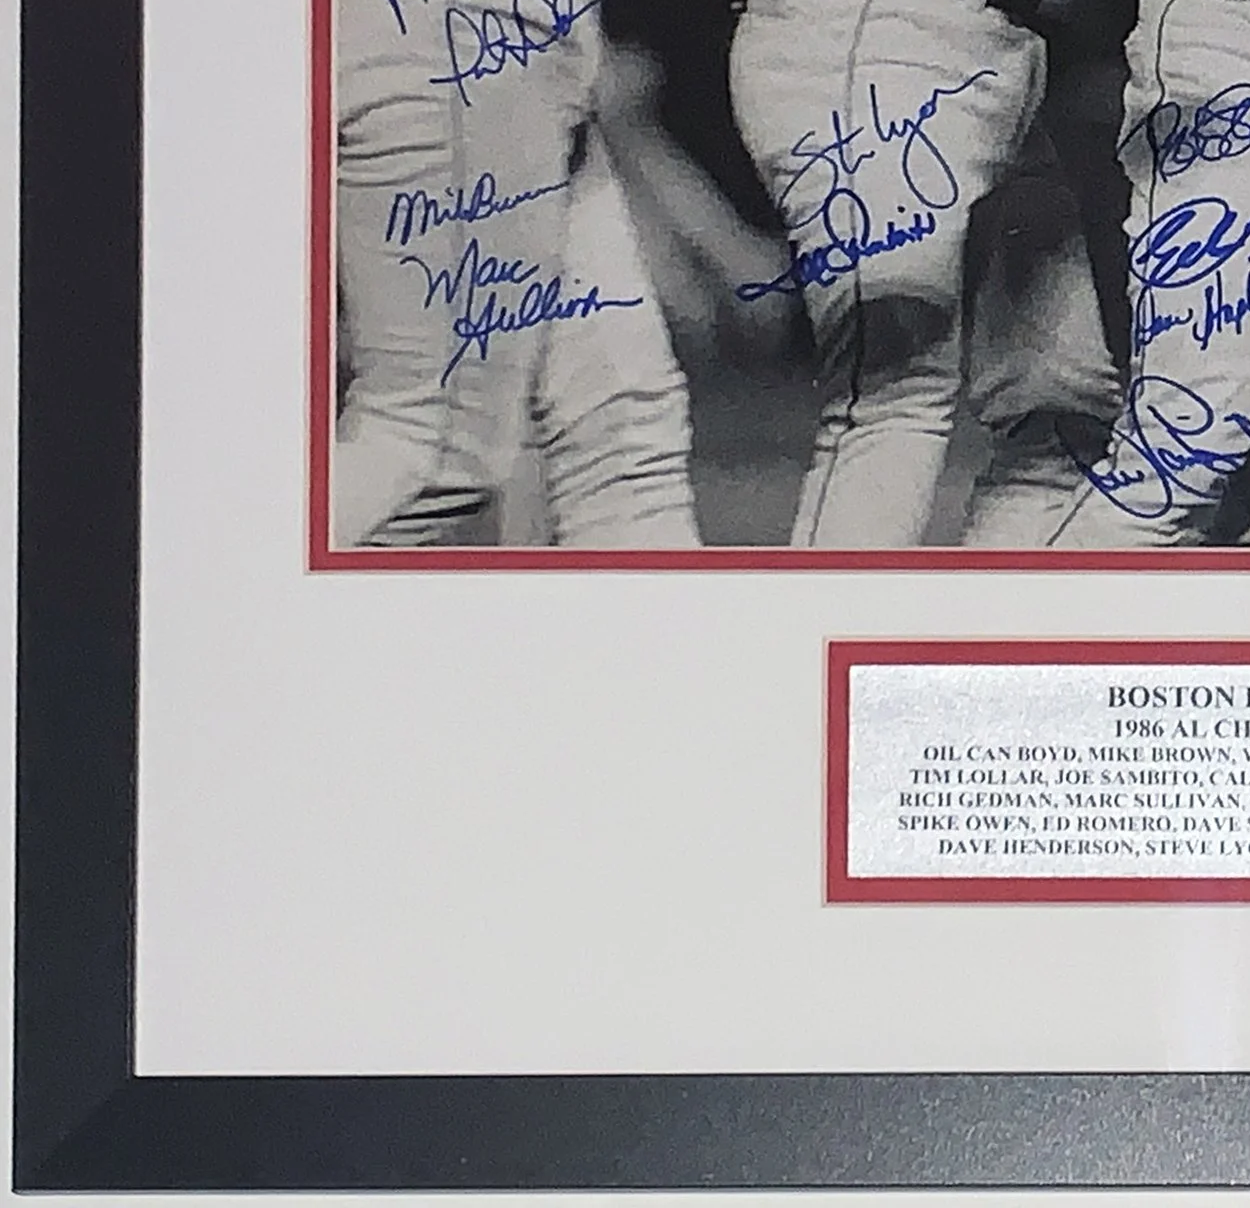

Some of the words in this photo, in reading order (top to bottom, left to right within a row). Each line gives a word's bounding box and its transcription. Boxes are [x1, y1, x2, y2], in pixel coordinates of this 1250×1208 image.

[1108, 686, 1235, 708] BOSTON
[1115, 718, 1164, 738] 1986
[1172, 718, 1207, 738] AL
[923, 745, 960, 762] OIL
[966, 745, 1011, 762] CAN
[1088, 746, 1145, 763] MIKE
[910, 768, 950, 786] TIM
[1054, 768, 1095, 786] JOE
[899, 791, 952, 809] RICH
[1063, 792, 1128, 810] MARC
[898, 815, 960, 832] SPIKE
[1042, 815, 1070, 832] ED
[1183, 816, 1241, 833] DAVE
[938, 838, 998, 856] DAVE
[1144, 839, 1213, 857] STEVE
